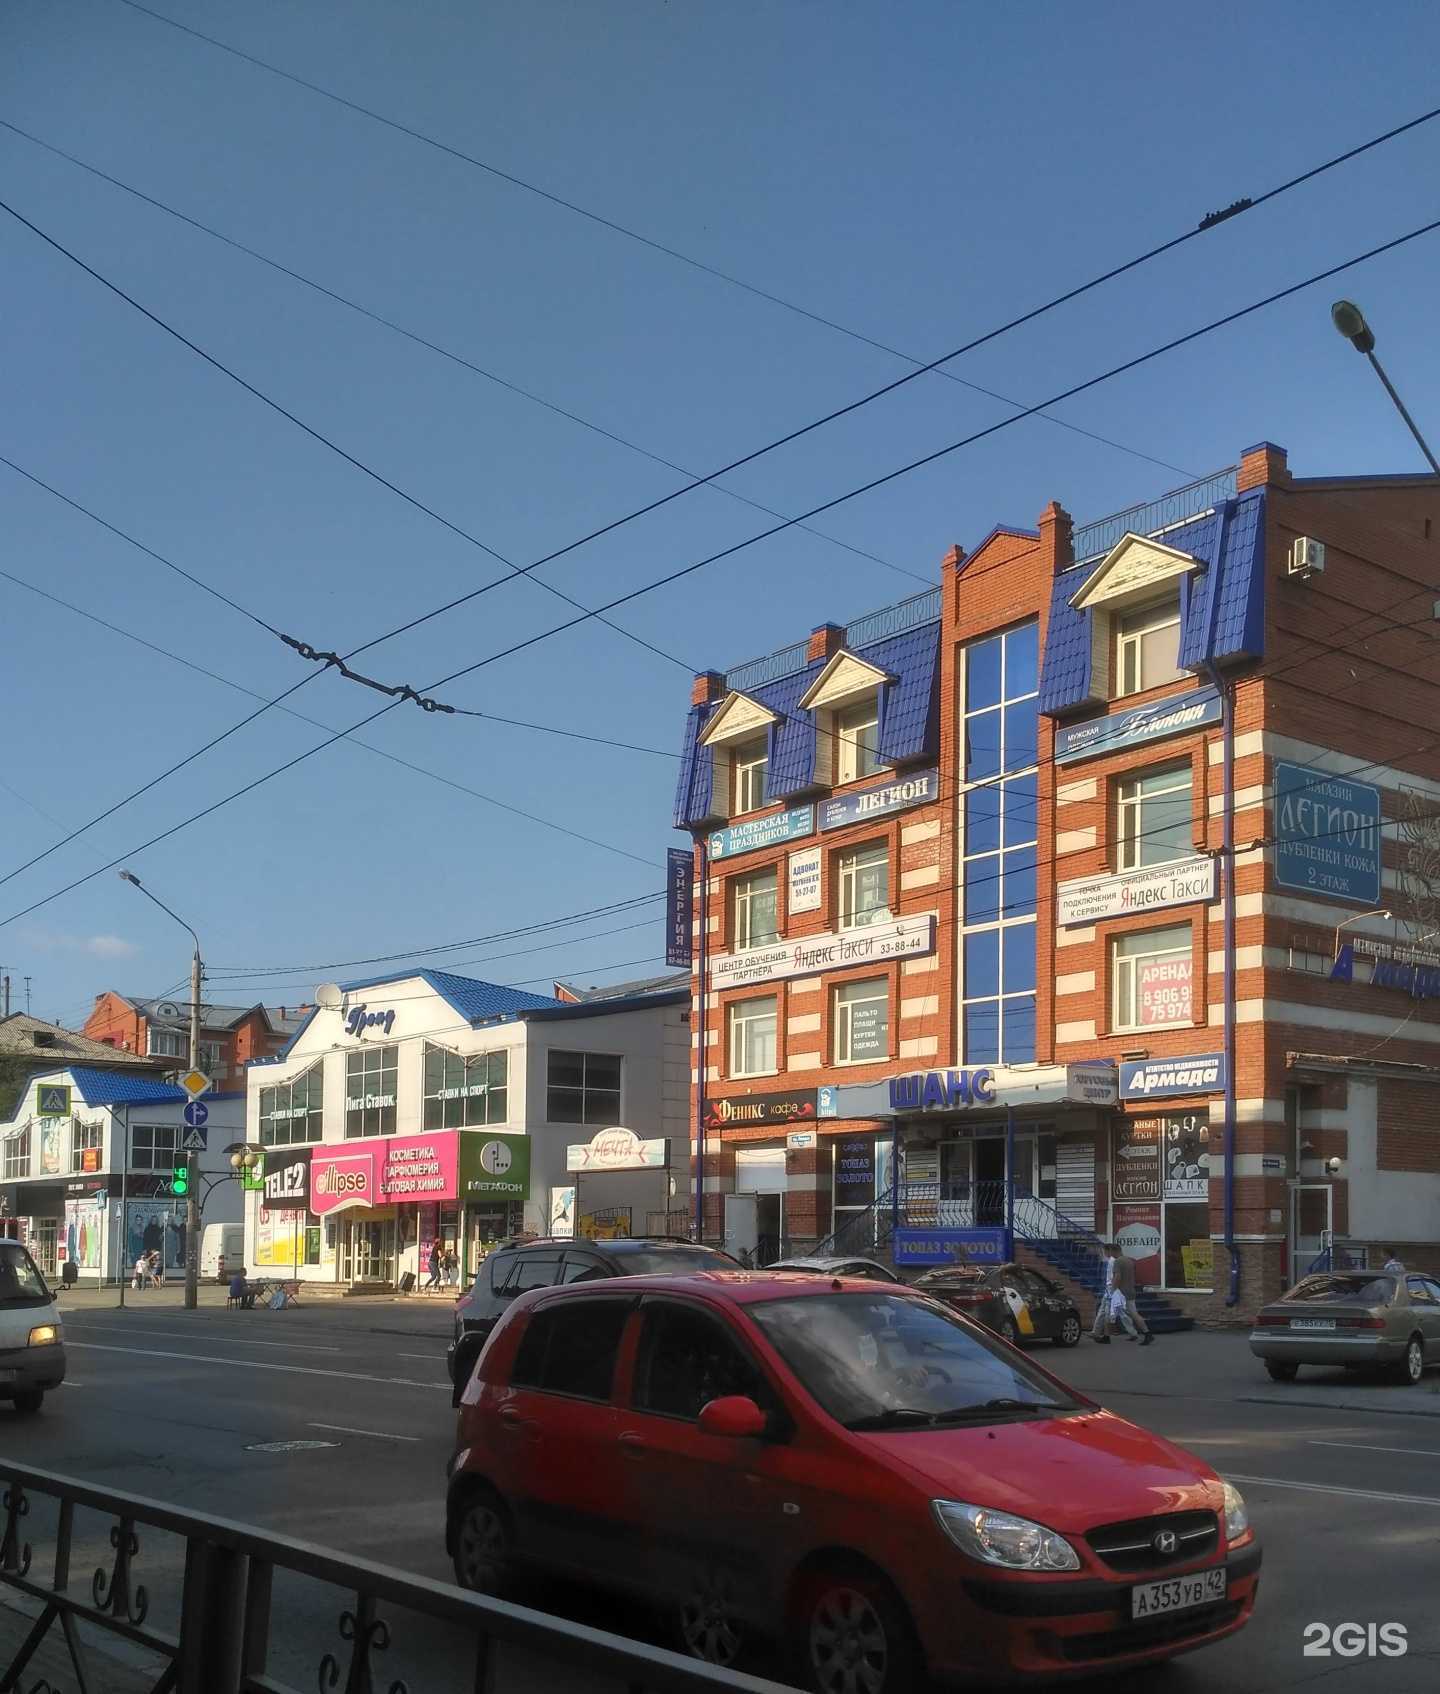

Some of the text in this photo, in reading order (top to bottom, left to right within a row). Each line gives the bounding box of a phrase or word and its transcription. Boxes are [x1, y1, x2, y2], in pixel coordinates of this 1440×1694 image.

[856, 777, 928, 814] ЛЕГИОН
[1305, 778, 1353, 801] МАГАЗИН
[730, 813, 789, 839] МАСТЕРСКАЯ
[1280, 794, 1376, 851] ЛЕГИОН
[729, 825, 789, 850] ПРАЗДНИКОВ
[1280, 840, 1377, 874] ДУБЛЕНКИ КОЖА
[1121, 863, 1209, 887] ОФИЦИАЛЬНЫЙ ПАРТНЕР
[1308, 867, 1350, 892] 2 ЭТАЖ
[1063, 892, 1117, 909] ПОДКЛЮЧЕНИЯ
[1121, 877, 1209, 909] Яндекс Такси
[1076, 905, 1109, 917] СЕРВИСУ
[793, 937, 874, 969] Яндекс Такси
[880, 937, 921, 954] 33-88-44
[718, 950, 787, 974] ЦЕНТР ОБУЧЕНИЯ
[733, 965, 773, 981] ПАРТНЕРА
[1144, 991, 1151, 1006] 8
[1154, 987, 1178, 1005] 906
[1150, 1005, 1165, 1021] 75
[438, 1083, 489, 1100] СТАВКИ НА СПОРТ
[889, 1068, 995, 1109] ШАНС
[1129, 1067, 1218, 1093] Армада
[346, 1094, 395, 1111] Лига Ставок
[770, 1103, 798, 1116] кафе
[389, 1147, 434, 1162] КОСМЕТИКА
[265, 1162, 306, 1198] TELE2
[316, 1165, 366, 1198] ellipse
[385, 1163, 439, 1178] ПАРФЮМЕРИЯ
[380, 1177, 445, 1195] БЫТОВАЯ ХИМИЯ
[1164, 1179, 1203, 1190] ШАПК
[903, 1241, 941, 1254] ТОПАЗ
[1137, 1571, 1223, 1615] А353УВ 42
